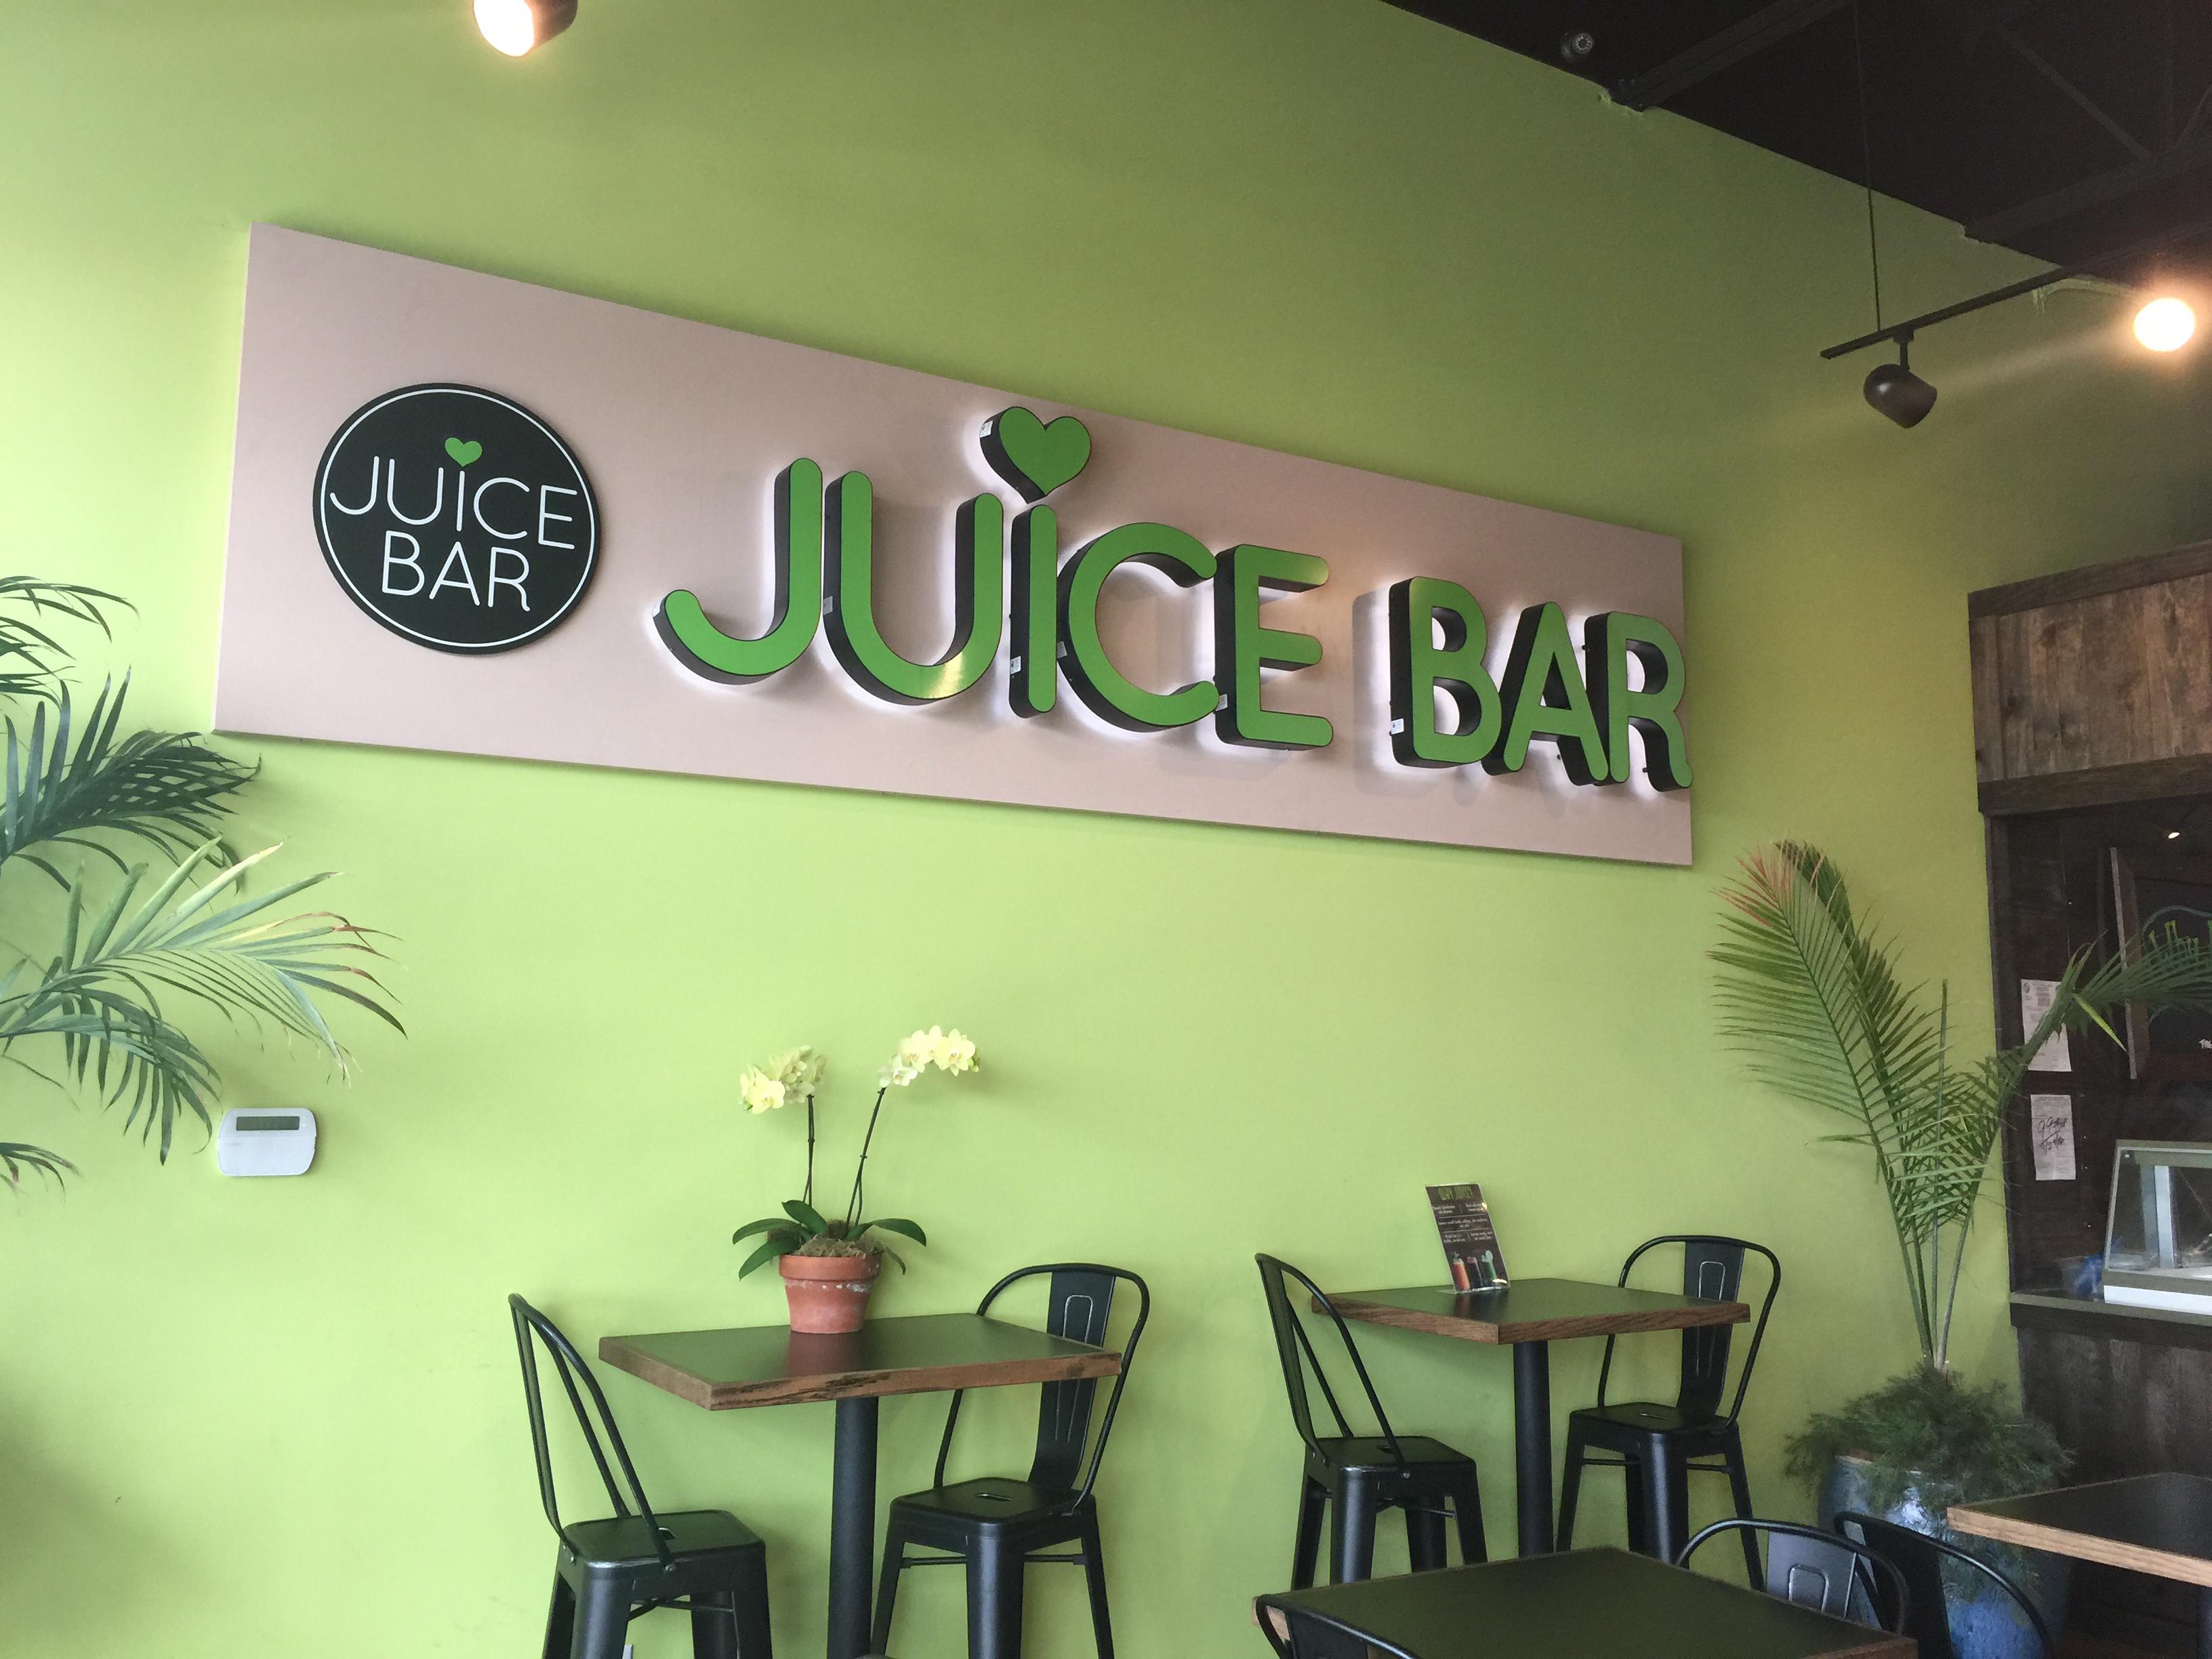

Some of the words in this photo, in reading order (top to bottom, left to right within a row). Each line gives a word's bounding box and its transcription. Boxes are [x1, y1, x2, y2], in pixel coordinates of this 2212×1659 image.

[330, 455, 578, 550] JUICE
[381, 530, 530, 612] BAR
[653, 458, 1334, 748] JUICE
[1389, 575, 1693, 792] BAR
